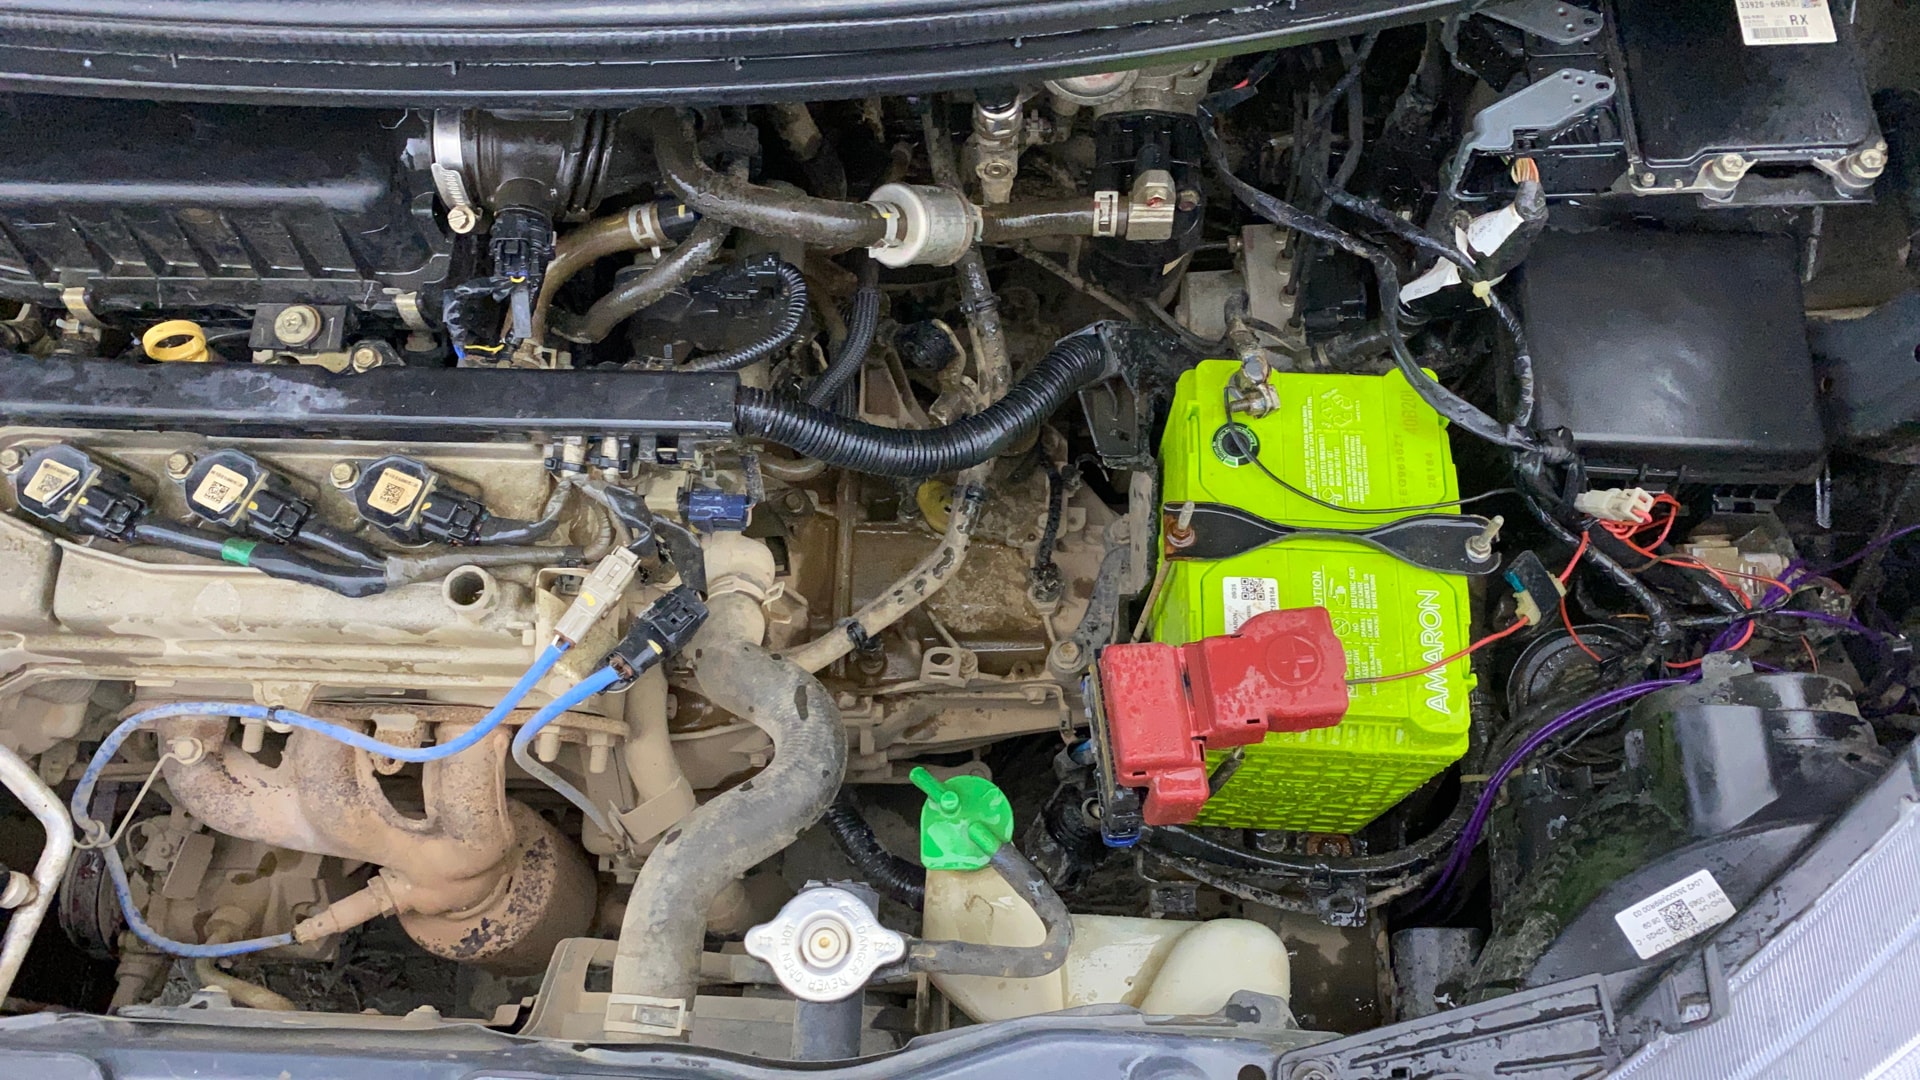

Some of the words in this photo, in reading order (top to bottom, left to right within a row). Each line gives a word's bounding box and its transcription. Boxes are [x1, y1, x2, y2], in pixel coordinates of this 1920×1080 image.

[1790, 14, 1808, 25] RX
[1416, 589, 1451, 714] AMARON
[782, 922, 796, 946] HOT
[850, 926, 868, 976] DANGER
[782, 952, 804, 982] OPEN
[808, 976, 850, 992] NEVER
